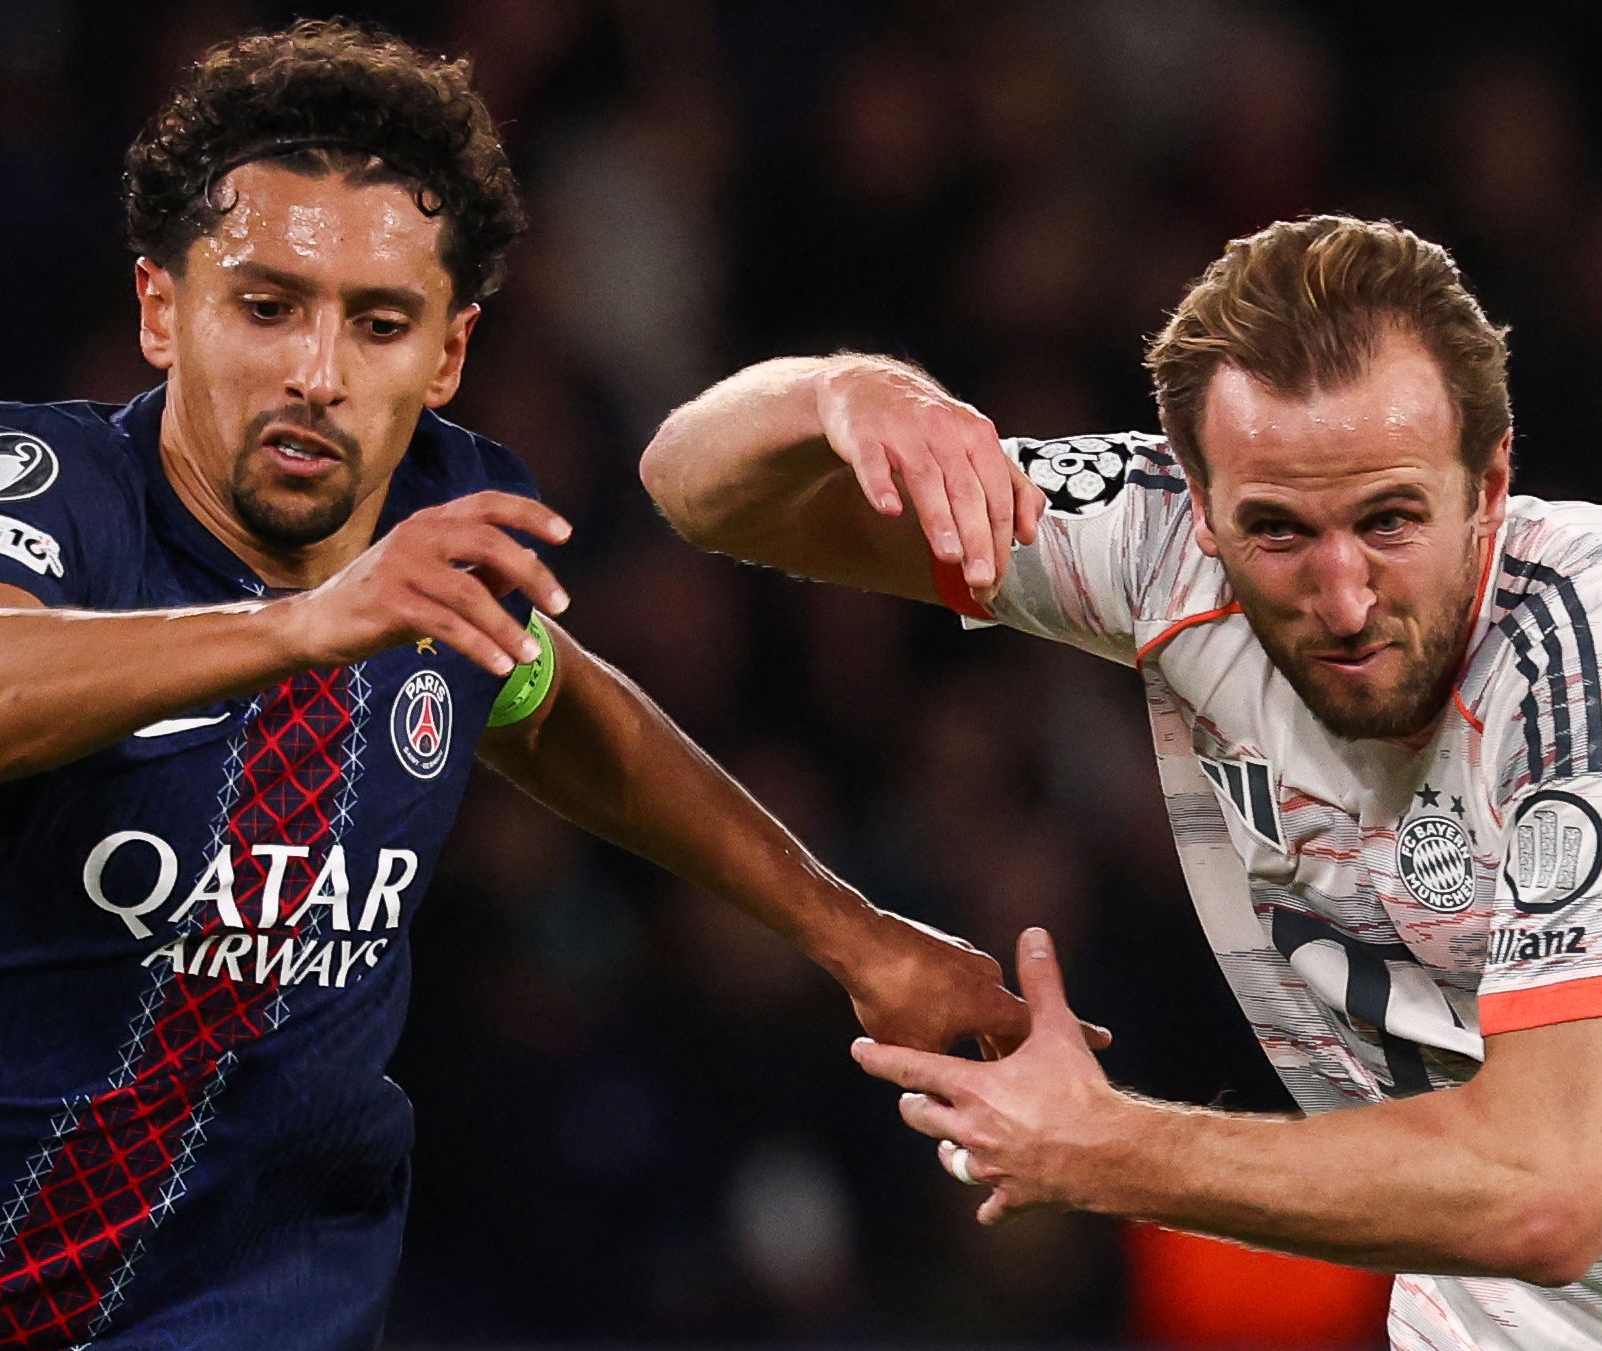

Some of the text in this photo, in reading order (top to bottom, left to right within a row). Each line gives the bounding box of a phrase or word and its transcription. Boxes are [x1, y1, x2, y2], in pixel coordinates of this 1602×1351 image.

[405, 676, 446, 702] PARIS
[1402, 823, 1470, 859] FC BAYERN
[83, 830, 418, 939] QATAR
